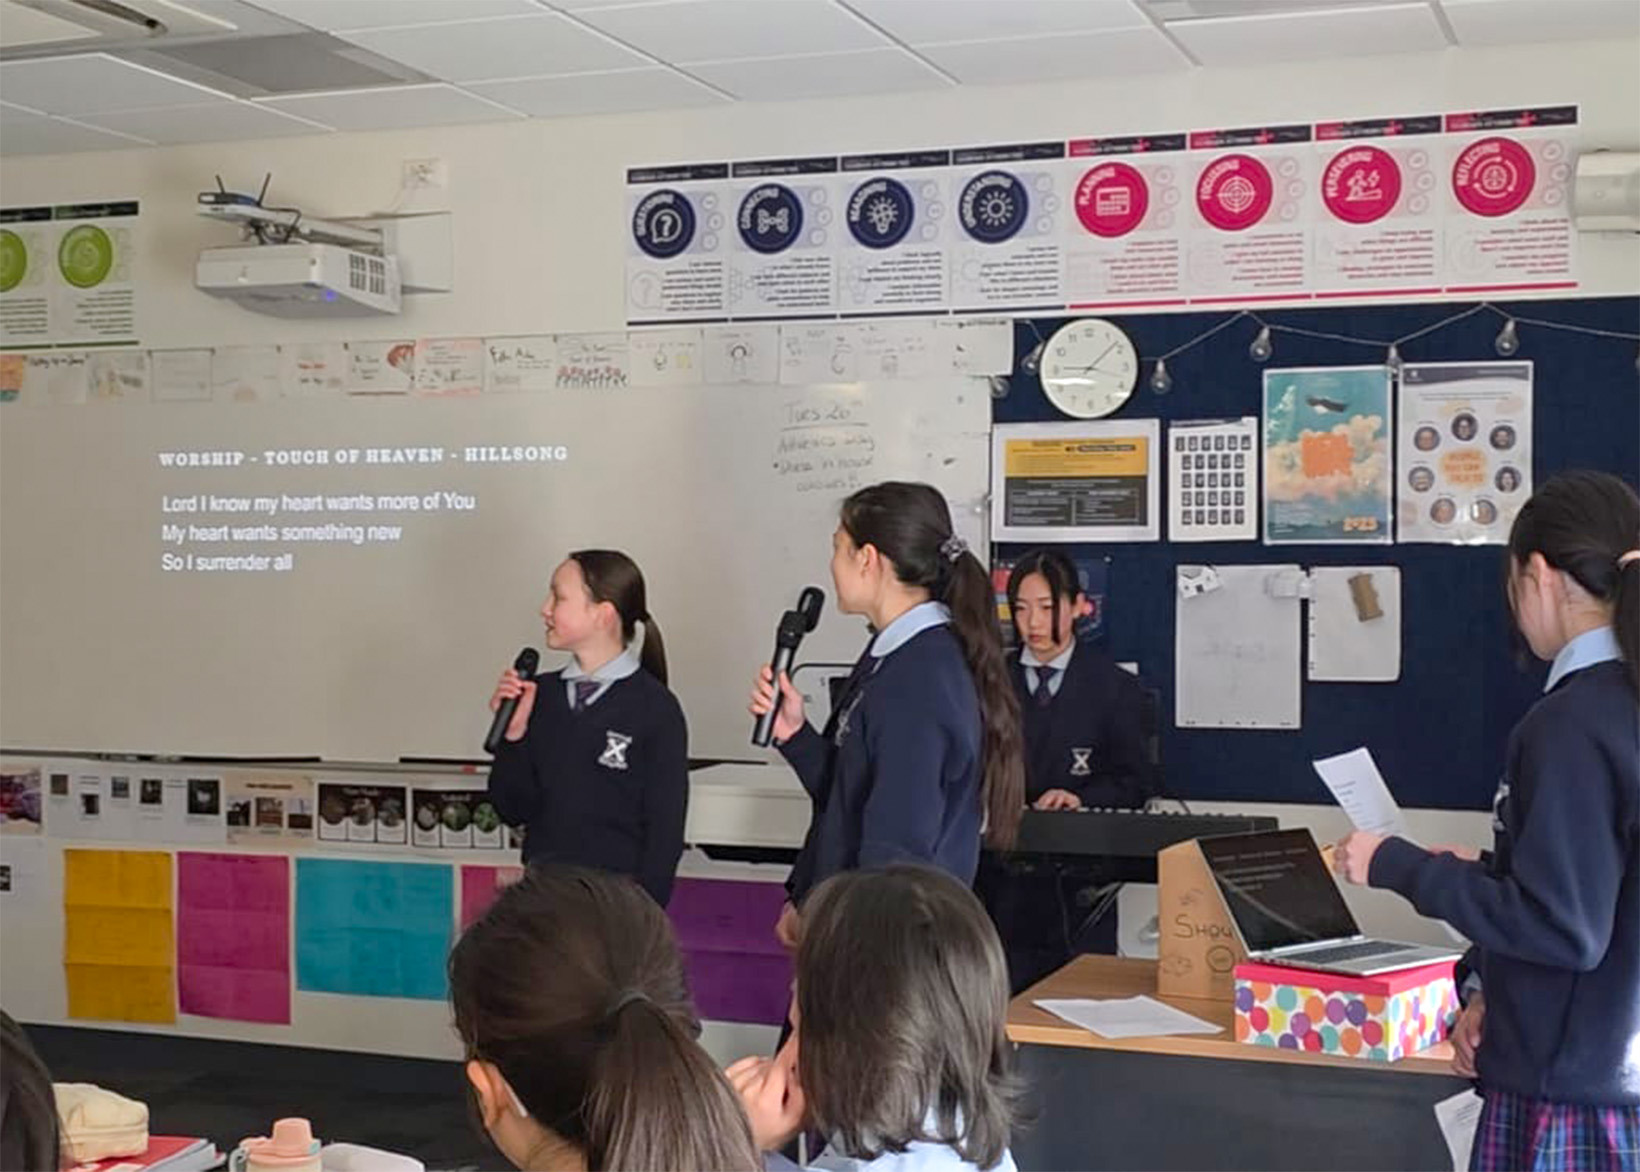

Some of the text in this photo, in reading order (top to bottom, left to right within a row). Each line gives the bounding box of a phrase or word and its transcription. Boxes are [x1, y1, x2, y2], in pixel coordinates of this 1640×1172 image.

[159, 452, 244, 466] WORSHIP
[264, 450, 329, 465] TOUCH
[335, 449, 359, 464] OF
[366, 448, 443, 463] HEAVEN
[465, 446, 567, 462] HILLSONG
[162, 492, 476, 515] Lord I know my heart wants more of You
[162, 522, 402, 545] My heart wants something new
[162, 553, 293, 571] So I surrender all
